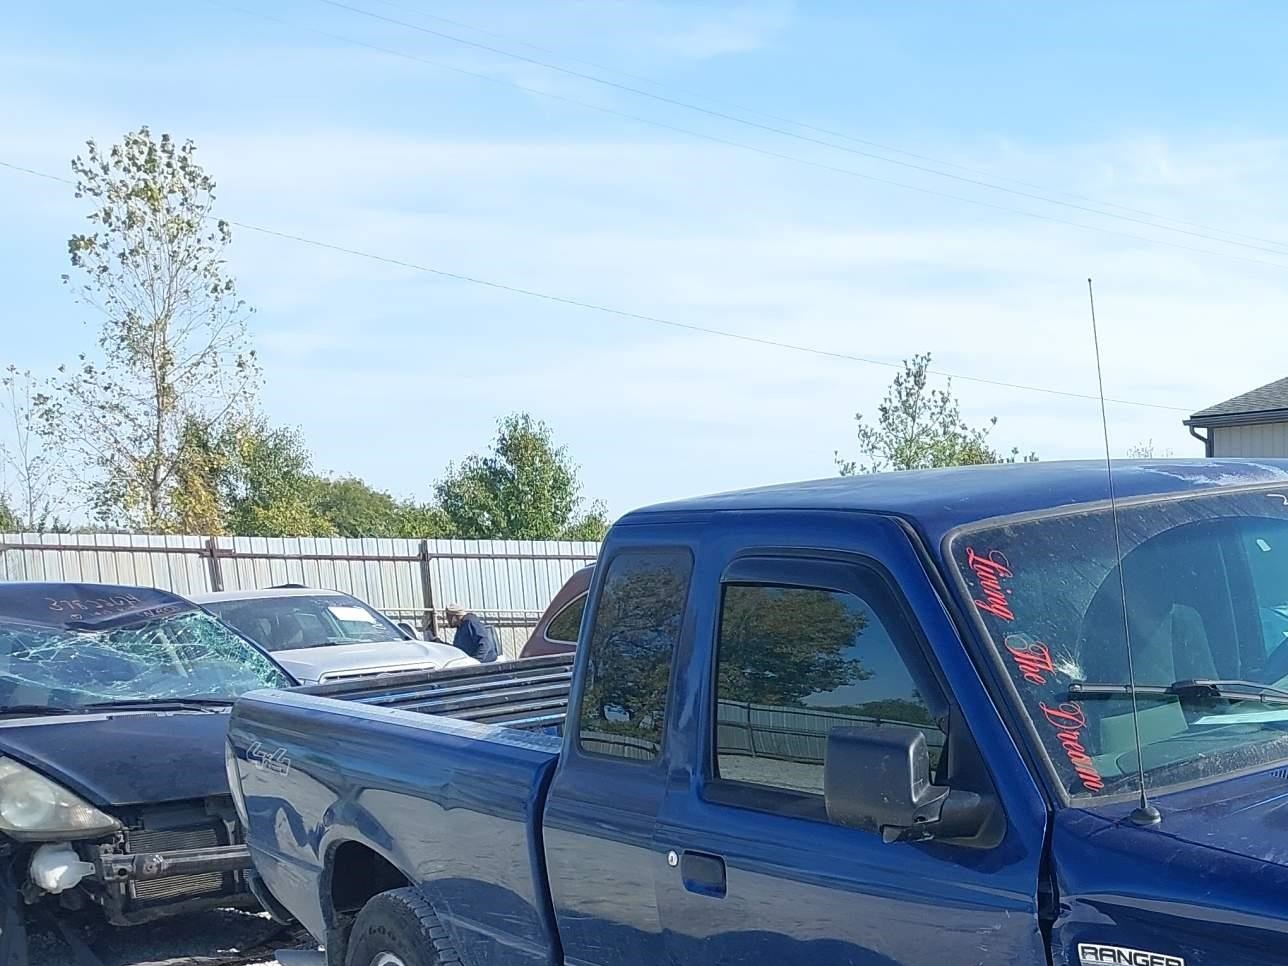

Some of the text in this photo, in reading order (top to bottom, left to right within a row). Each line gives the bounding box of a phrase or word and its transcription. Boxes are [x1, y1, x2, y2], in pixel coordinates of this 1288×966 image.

[966, 547, 1105, 792] Living The Dream
[246, 740, 291, 776] 4x4
